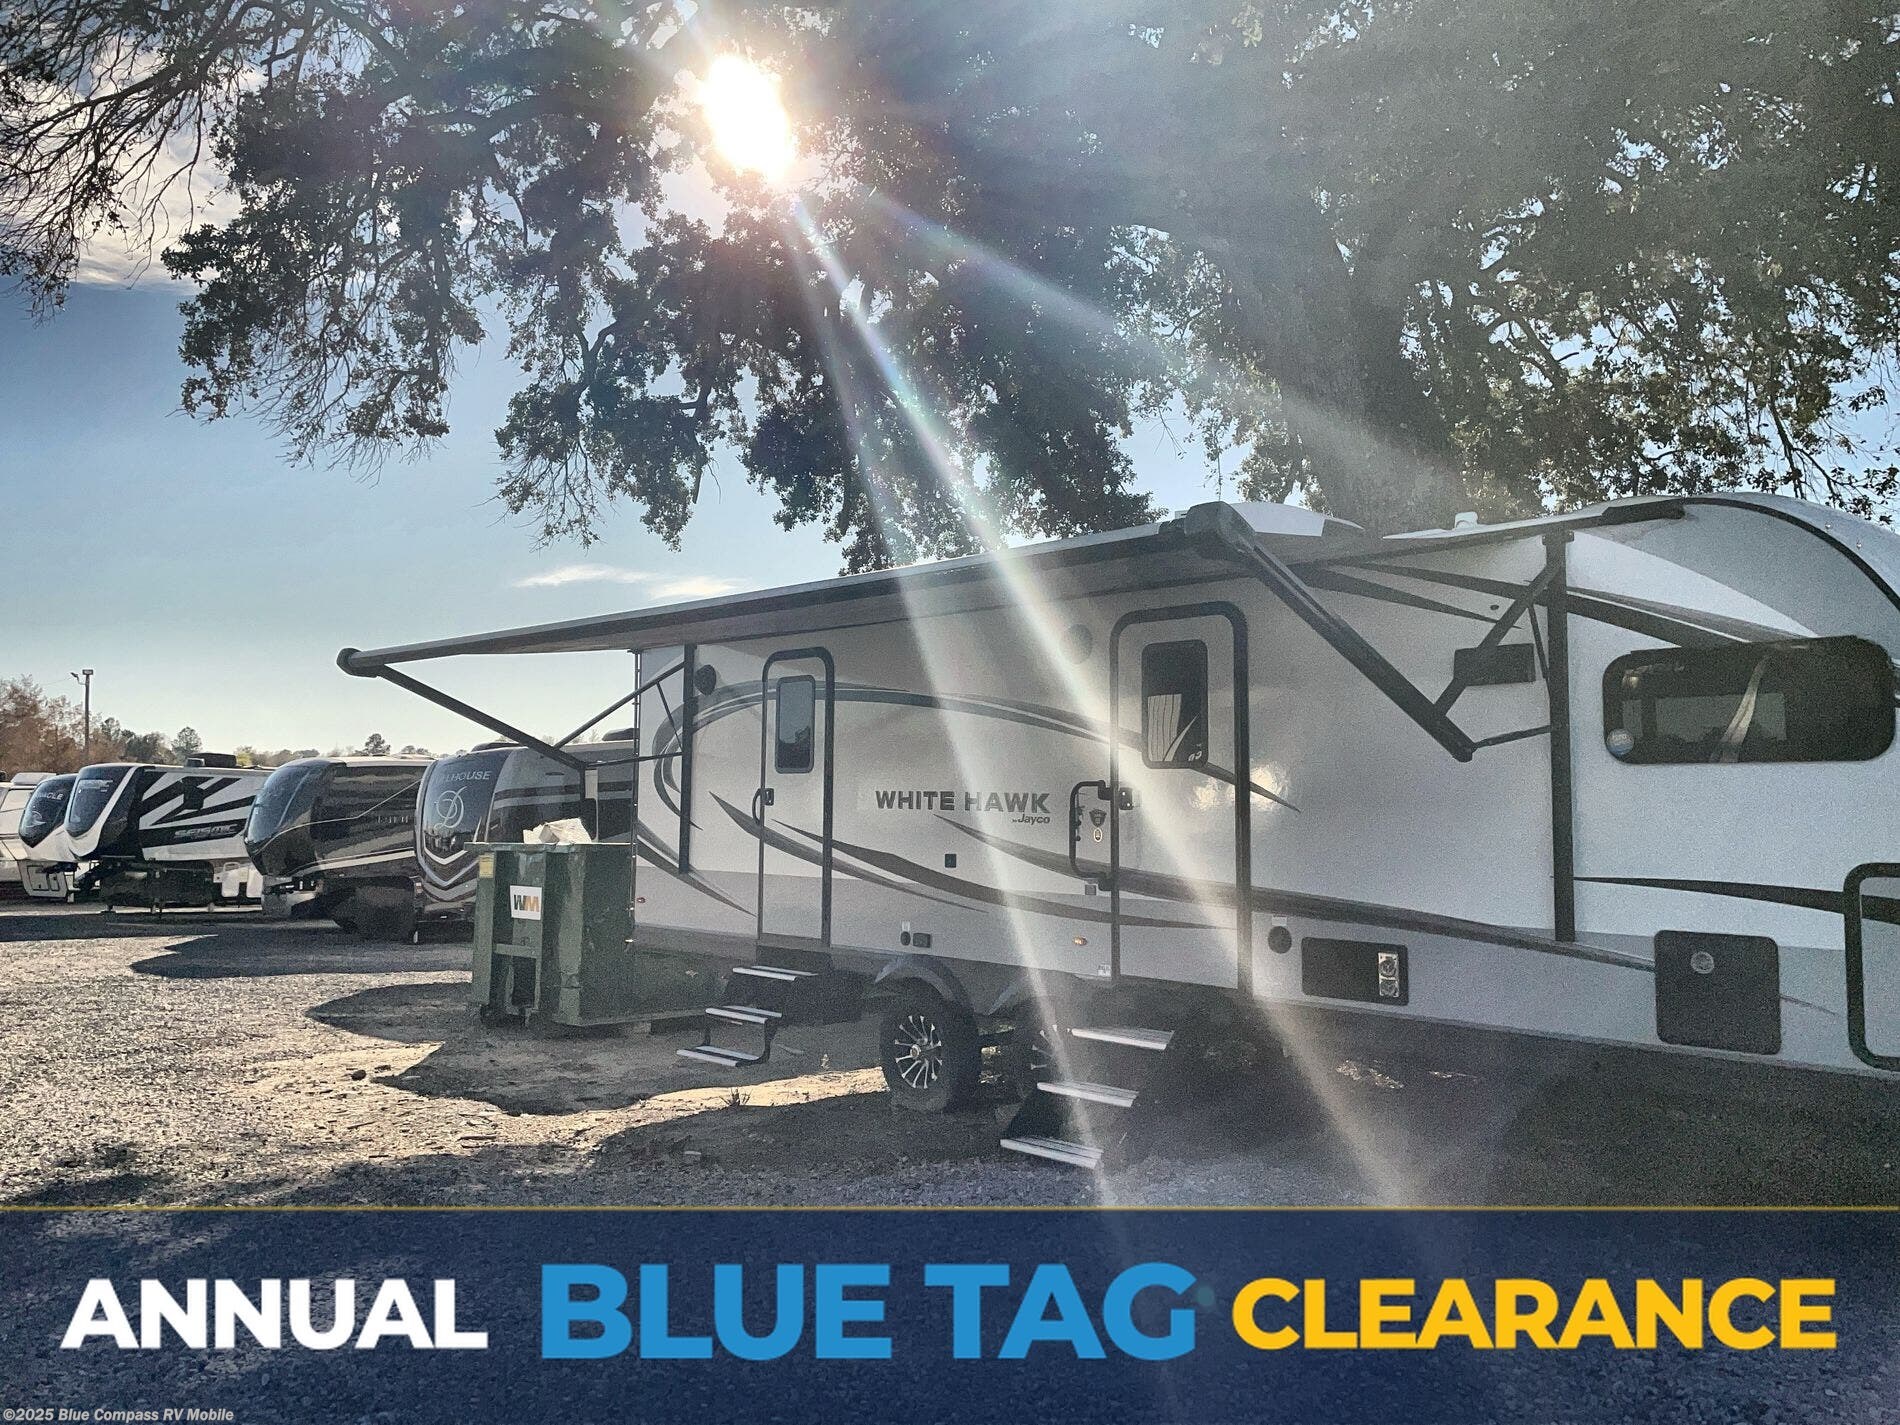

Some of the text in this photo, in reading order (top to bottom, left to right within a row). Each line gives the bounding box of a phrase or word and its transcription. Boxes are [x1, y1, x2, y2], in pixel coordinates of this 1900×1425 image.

[875, 790, 1051, 814] WHITE HAWK
[1018, 813, 1051, 826] Jayco
[513, 894, 540, 912] WM
